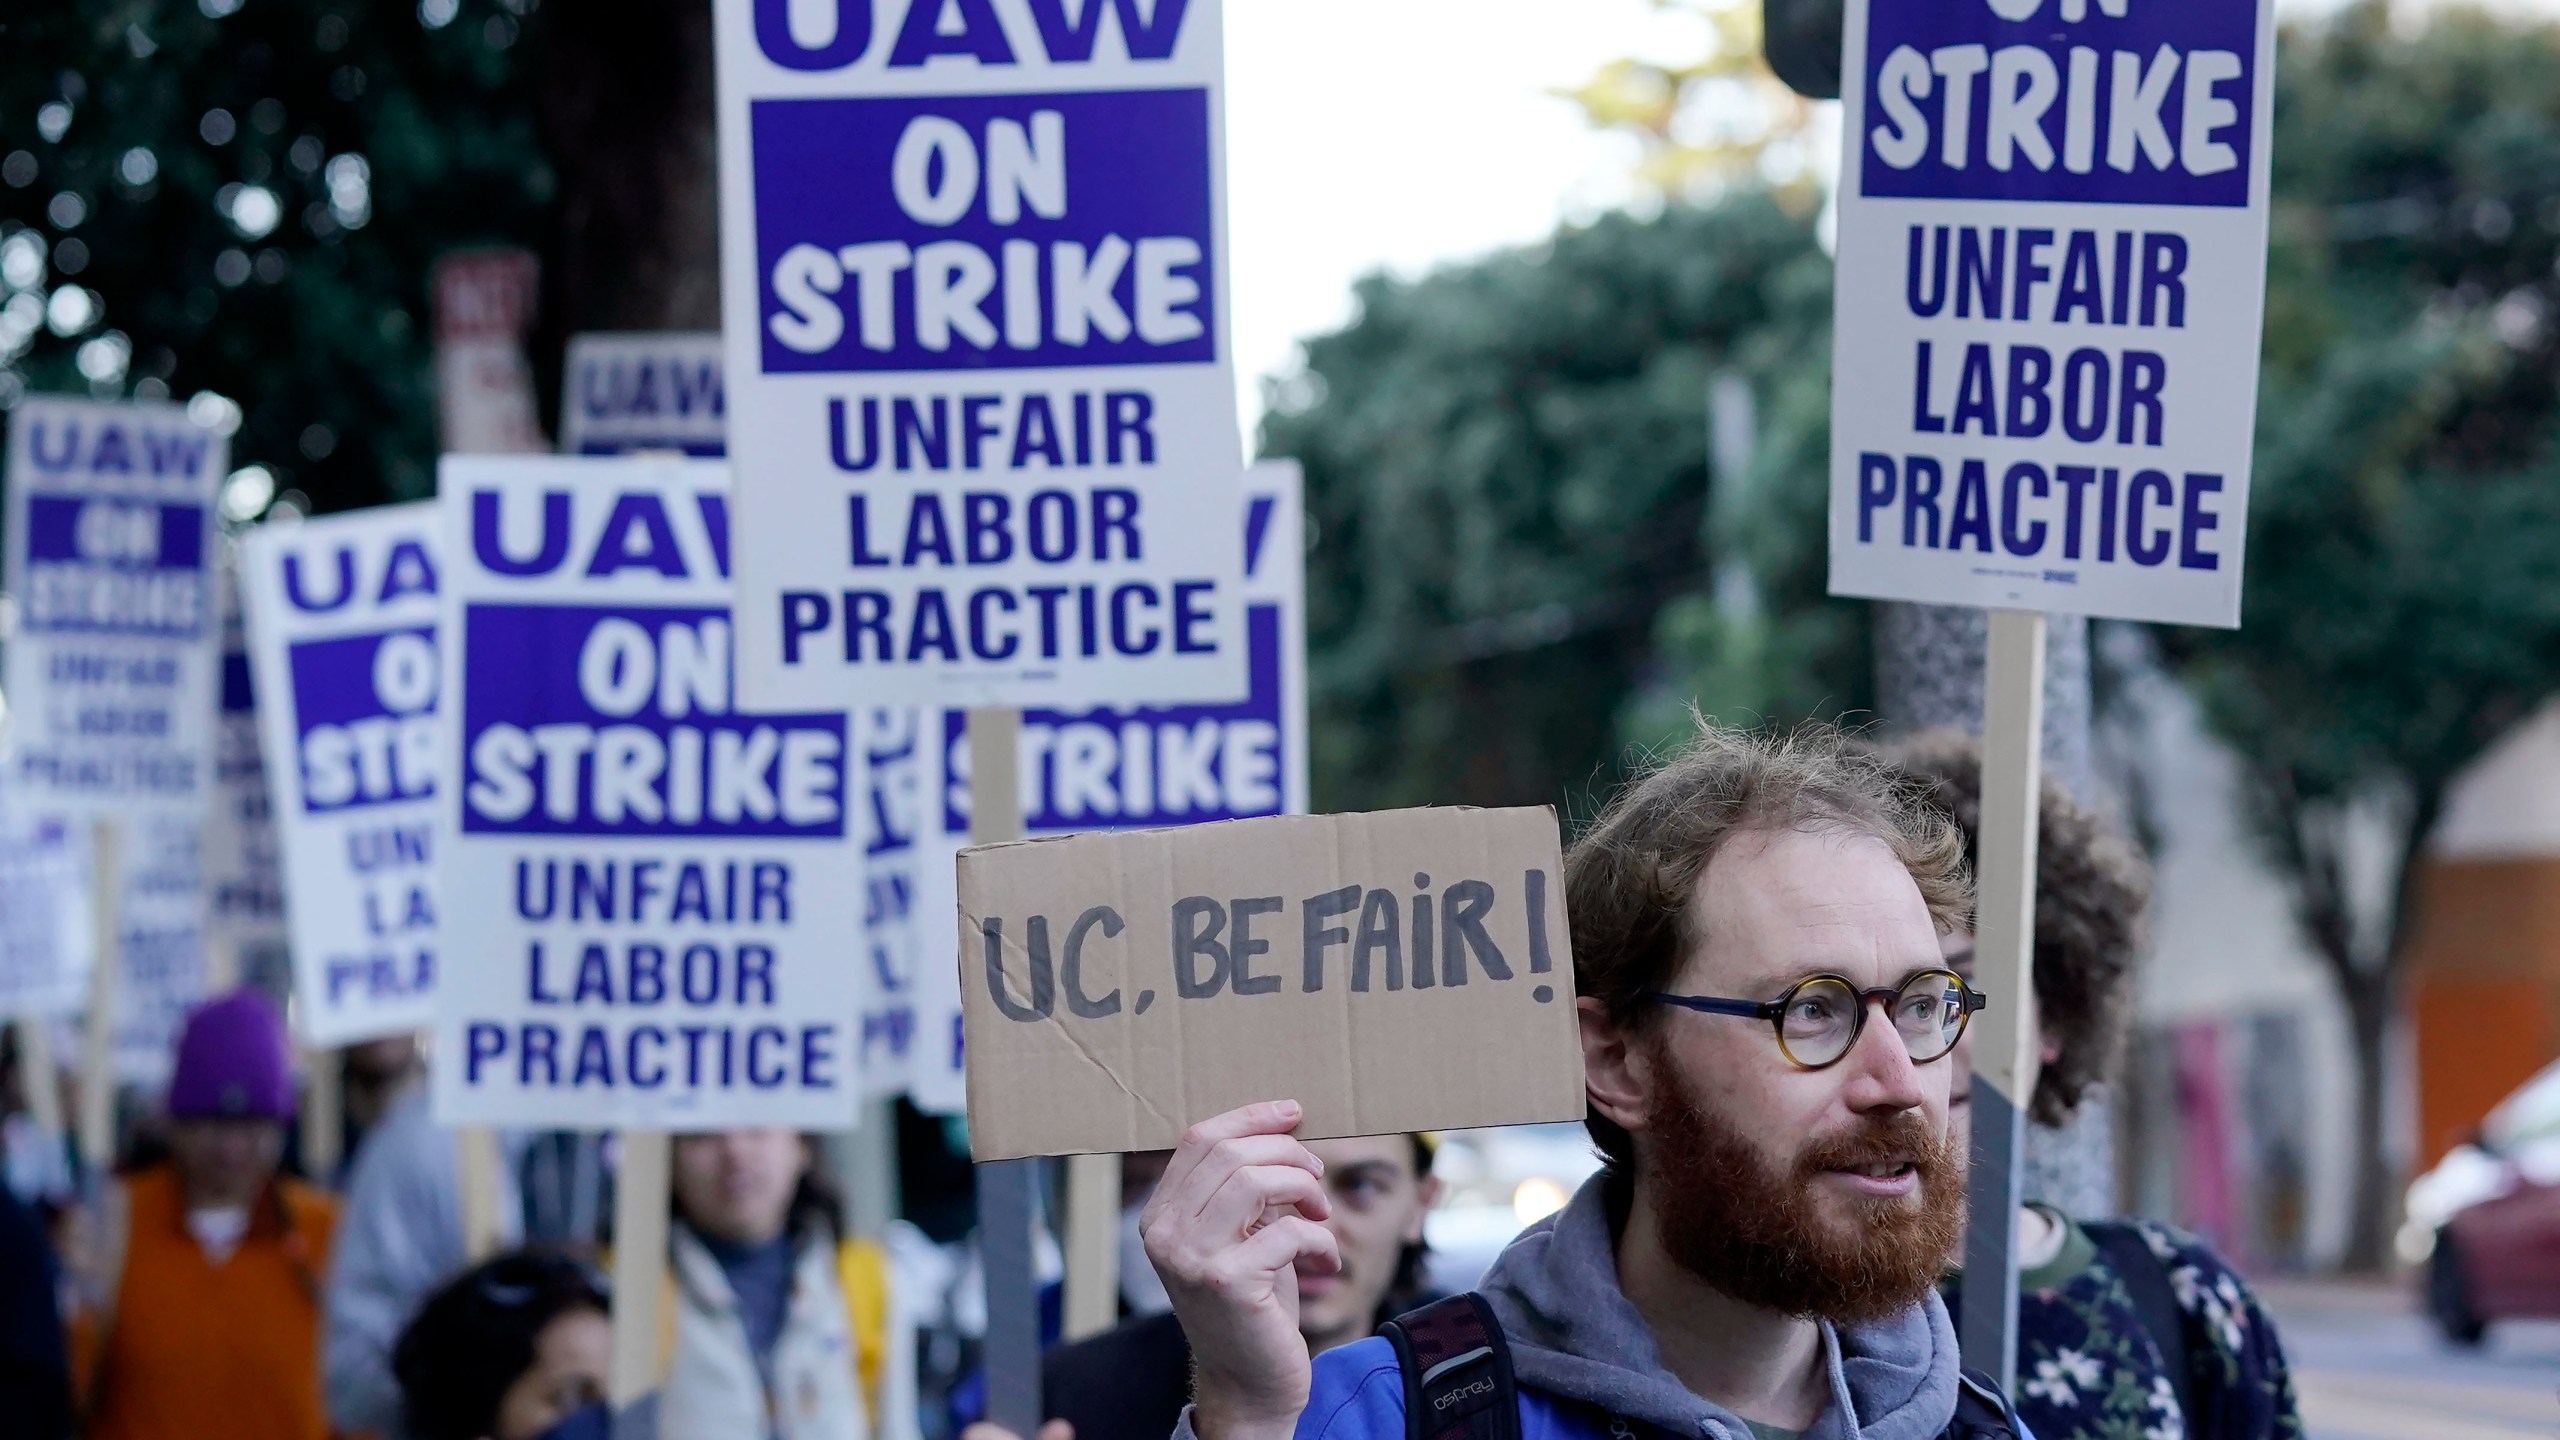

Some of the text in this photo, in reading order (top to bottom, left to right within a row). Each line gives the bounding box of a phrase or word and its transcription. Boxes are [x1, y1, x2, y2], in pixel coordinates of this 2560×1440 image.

[752, 0, 1190, 72] UAW
[1871, 43, 2243, 176] STRIKE
[892, 110, 1066, 226] ON
[768, 232, 1204, 354] STRIKE
[1906, 225, 2188, 329] UNFAIR
[828, 389, 1157, 472] UNFAIR
[1914, 340, 2167, 447] LABOR
[471, 489, 730, 579] UA
[848, 487, 1142, 567] LABOR
[1858, 452, 2224, 570] PRACTICE
[578, 617, 730, 718] ON
[780, 580, 1219, 664] PRACTICE
[467, 721, 842, 826] STRIKE
[515, 859, 792, 923] UNFAIR
[528, 941, 776, 1006] LABOR
[983, 906, 1156, 1023] UC,
[1171, 895, 1284, 999] BE
[467, 1023, 836, 1089] PRACTICE
